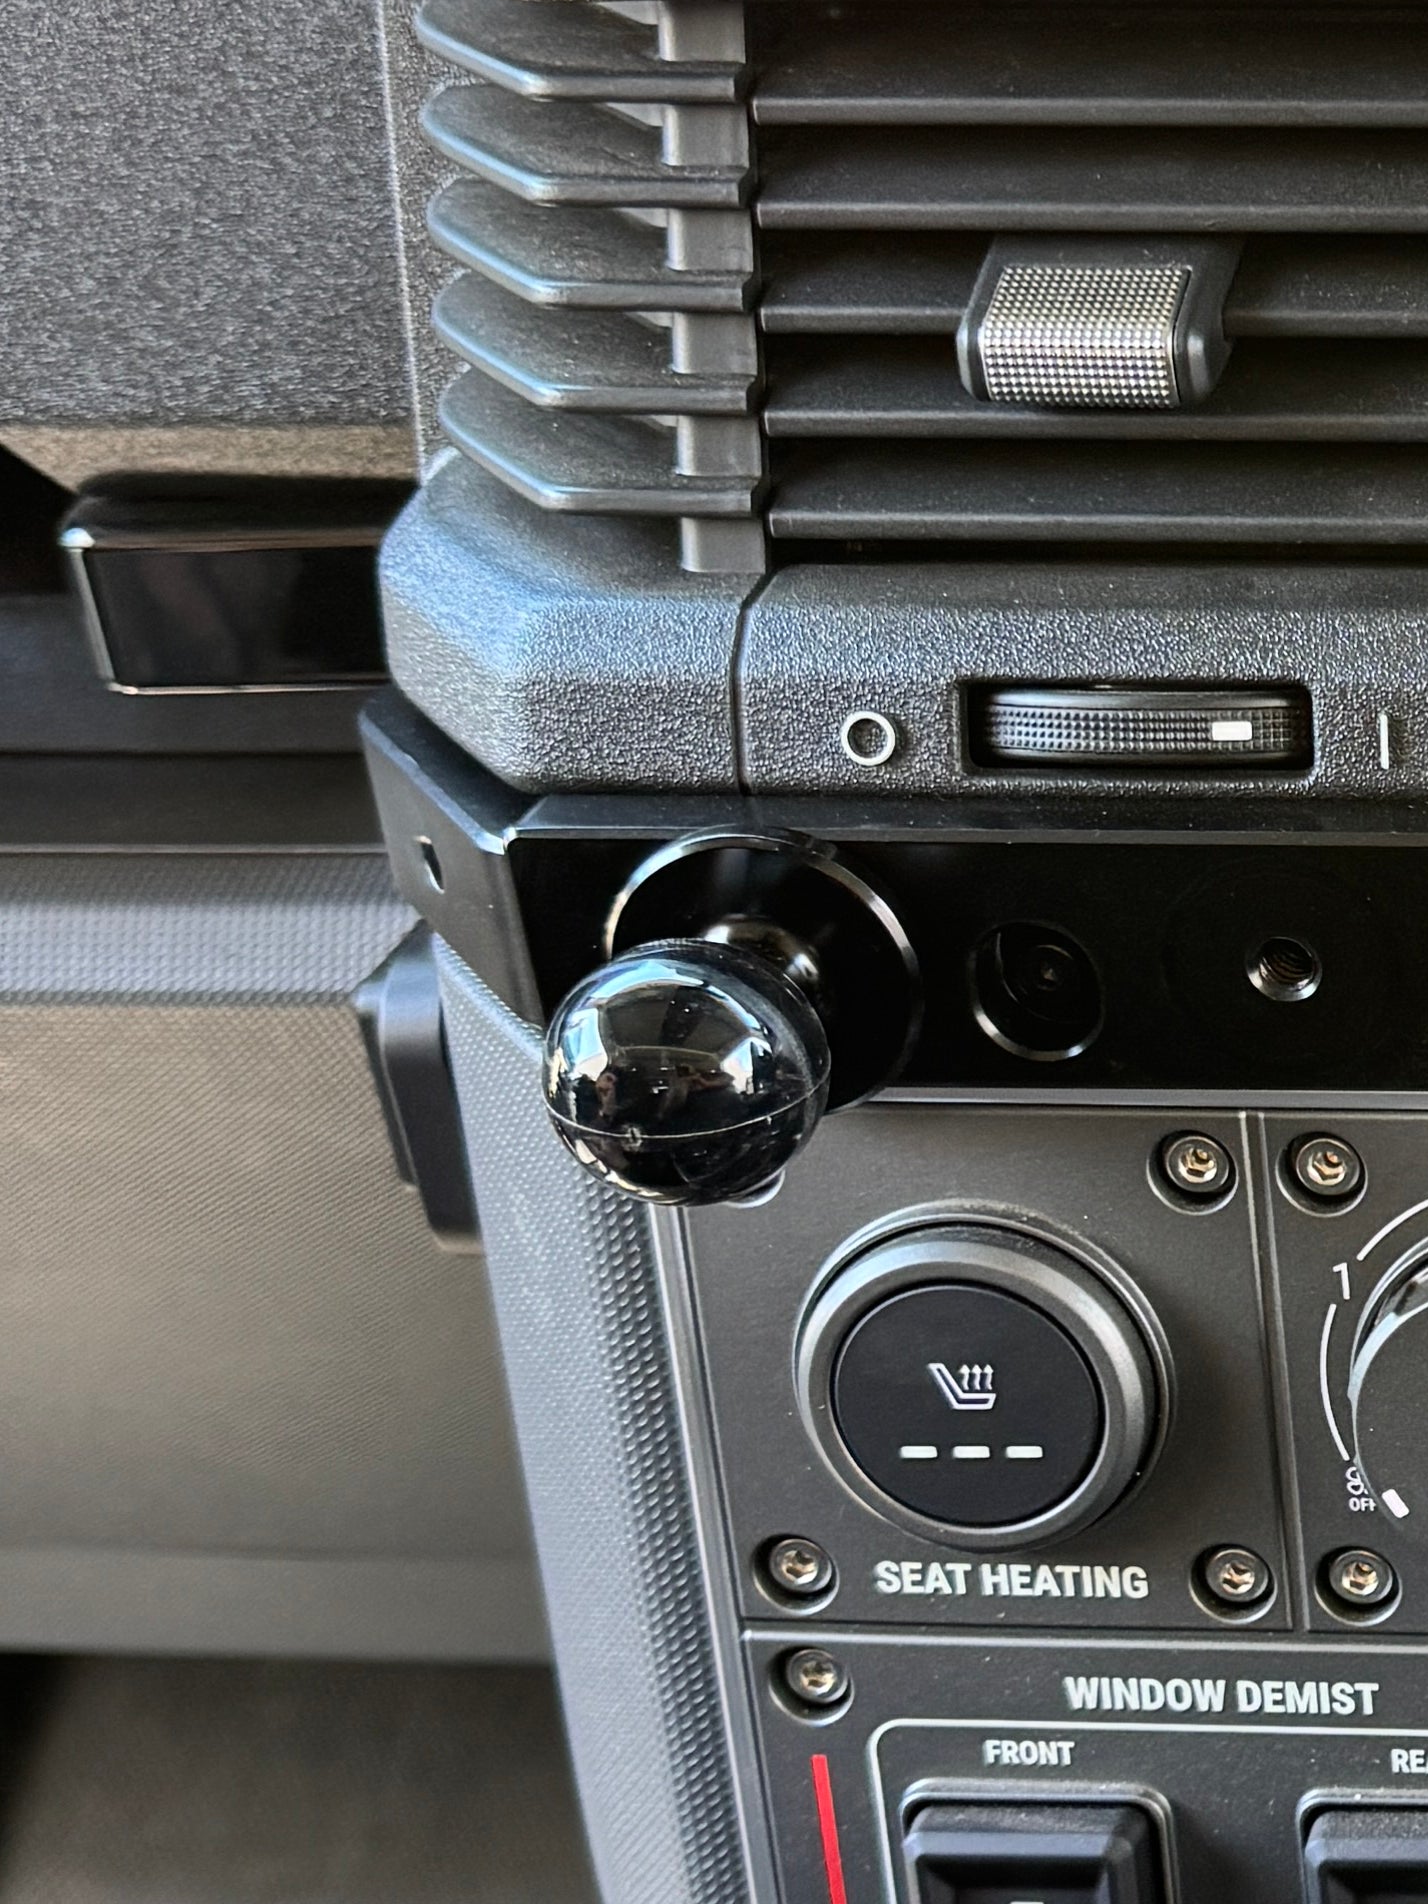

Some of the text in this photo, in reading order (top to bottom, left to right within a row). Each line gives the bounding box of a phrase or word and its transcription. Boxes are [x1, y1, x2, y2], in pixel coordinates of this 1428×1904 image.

[1333, 1263, 1350, 1299] 1
[874, 1561, 1148, 1598] SEAT HEATING
[1063, 1677, 1379, 1715] WINDOW DEMIST
[983, 1740, 1075, 1766] FRONT
